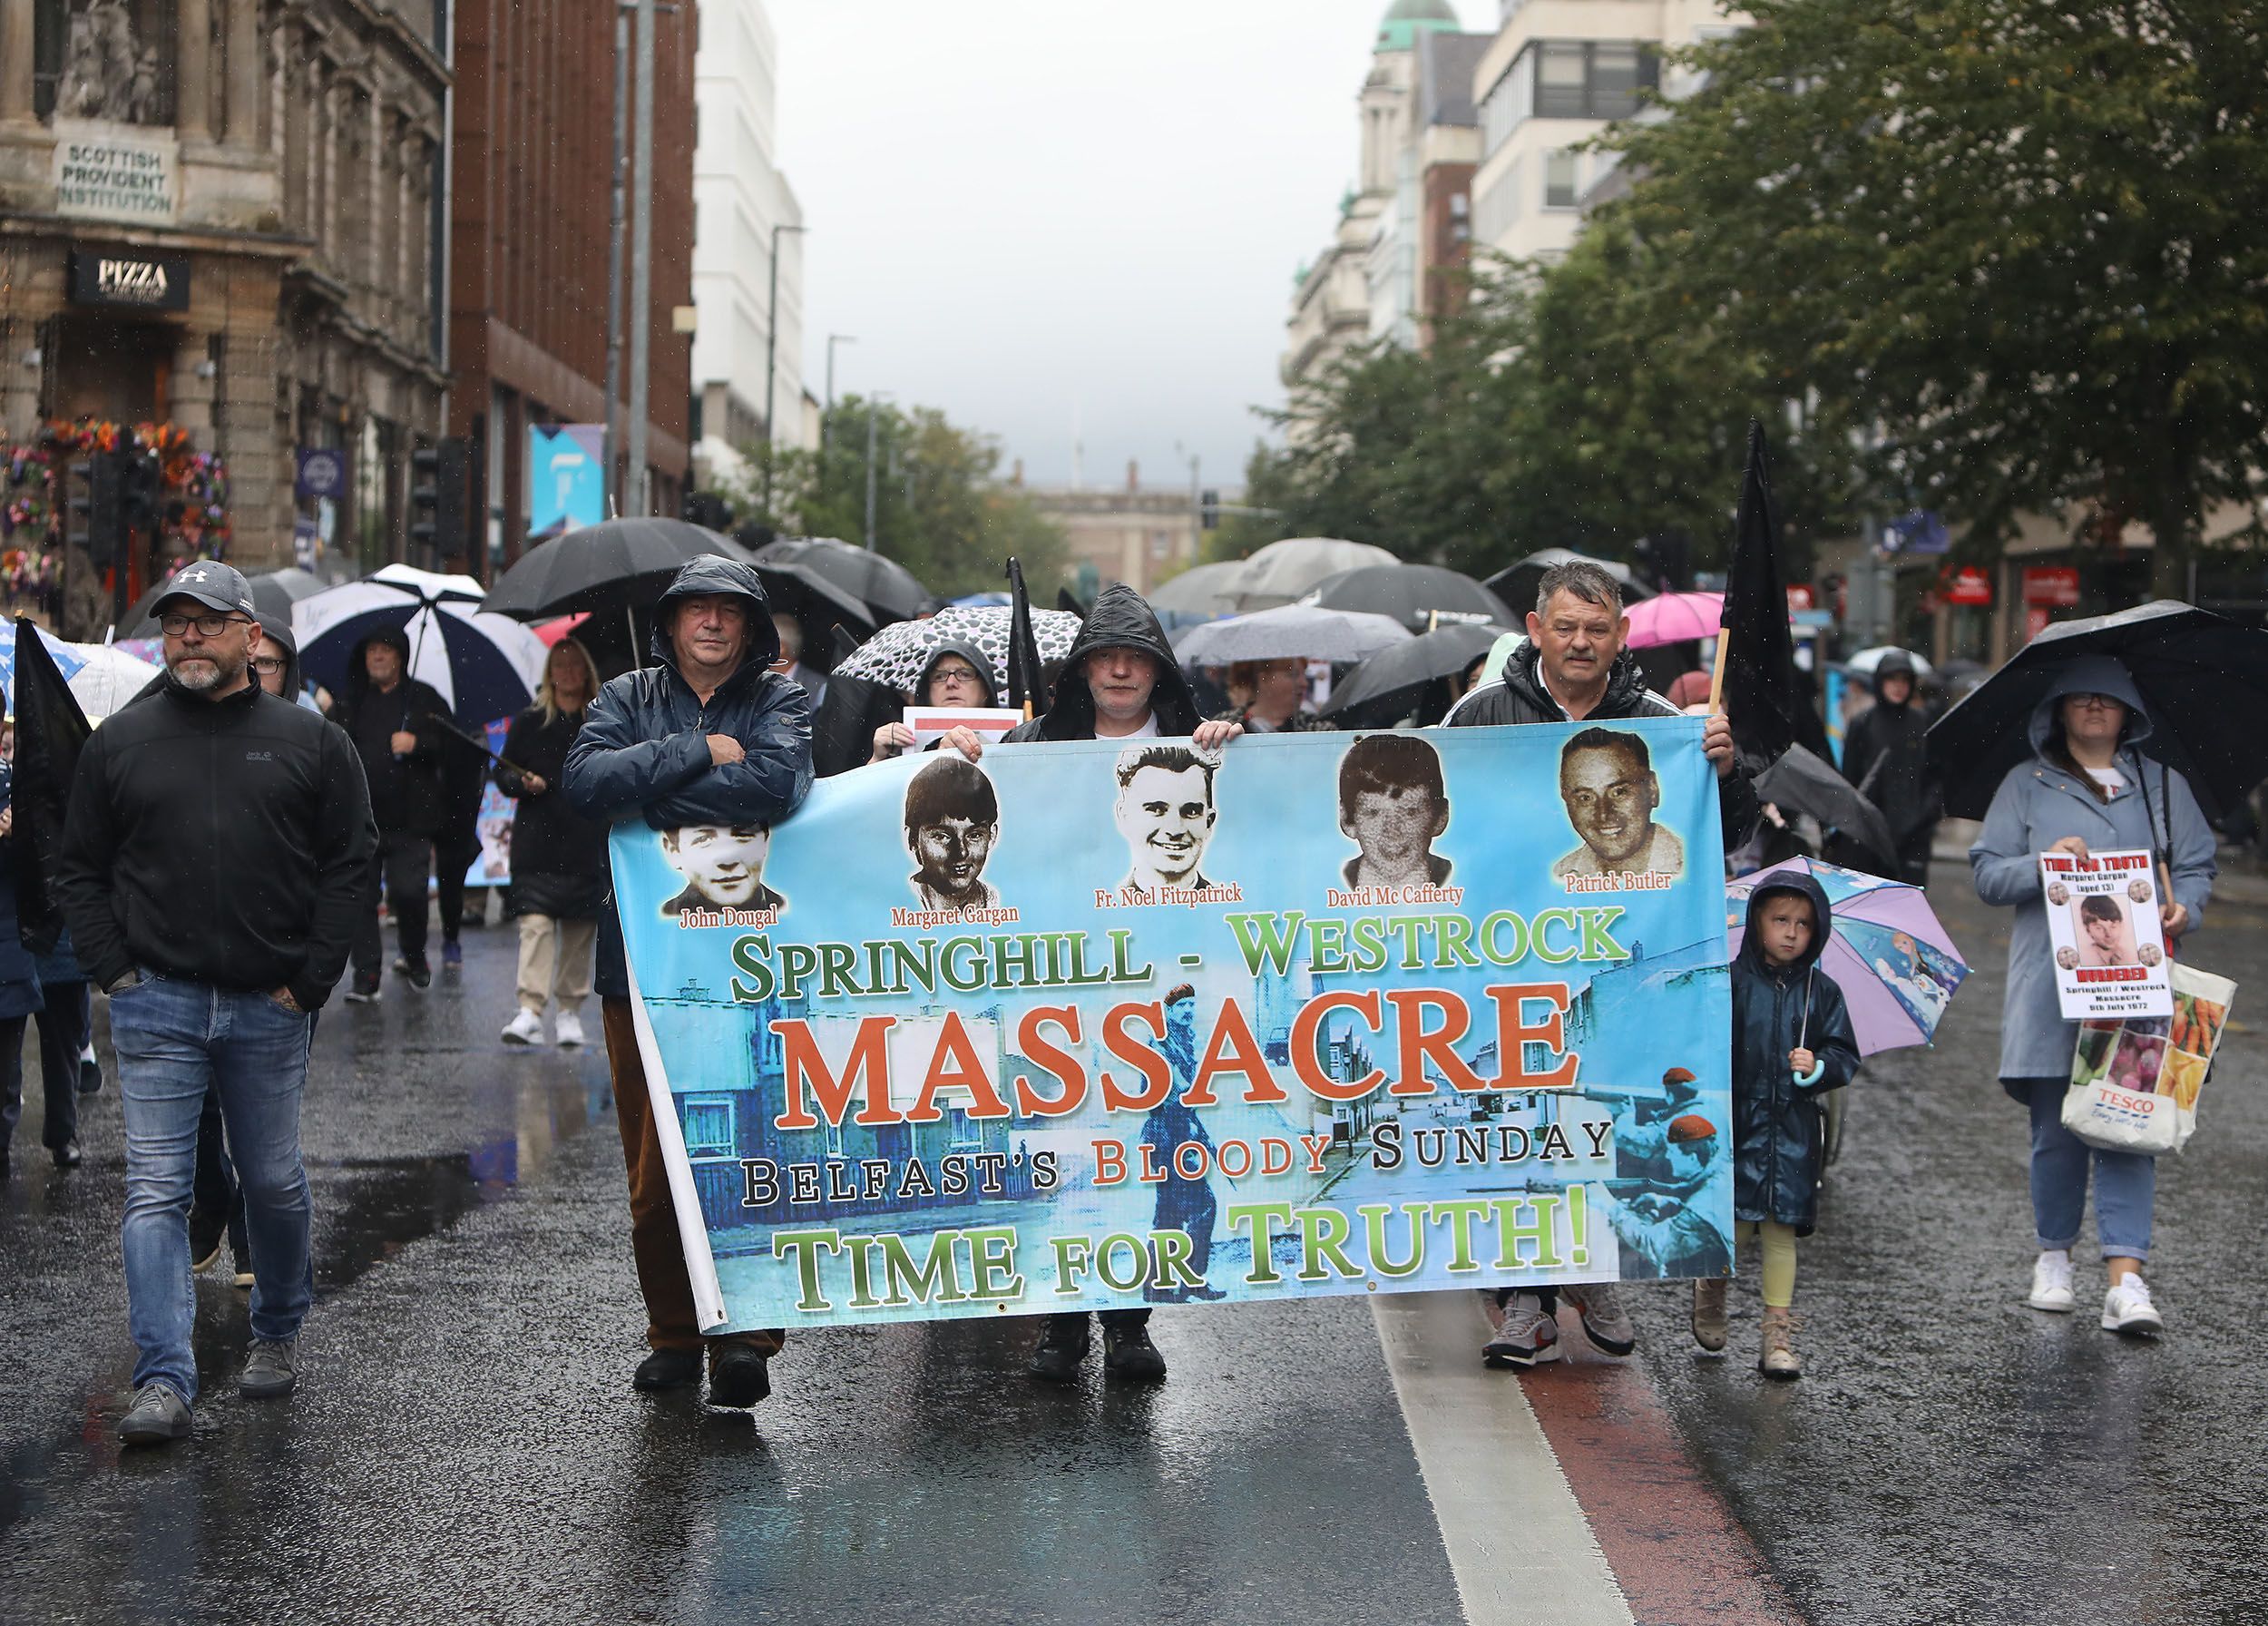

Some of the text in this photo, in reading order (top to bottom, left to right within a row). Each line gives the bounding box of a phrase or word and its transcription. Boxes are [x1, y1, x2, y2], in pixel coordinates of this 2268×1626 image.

[69, 145, 161, 169] SCOTTISH
[63, 164, 165, 191] PROVIDENT
[98, 259, 167, 289] PIZZA
[2044, 857, 2074, 871] TIME
[2103, 855, 2148, 870] TRUTH
[1566, 870, 1671, 893] Patrick Butler
[2060, 871, 2128, 882] Margaret Gargan
[1095, 882, 1243, 907] Fr. Noel Fitzpatrick
[1327, 882, 1464, 907] David Mc Cafferty
[679, 903, 778, 929] John Dougal
[891, 905, 1019, 930] Margaret Gargan
[731, 931, 1152, 1002] SPRINGHILL
[1226, 906, 1630, 976] WESTROCK
[2076, 967, 2149, 983] MURDERED
[2066, 986, 2112, 994] Springhill
[2121, 984, 2167, 993] Westrock
[2096, 994, 2142, 1003] Massacre
[2107, 1003, 2126, 1012] July
[768, 983, 1579, 1130] MASSACRE
[2099, 1088, 2155, 1113] TESCO
[741, 1120, 1613, 1207] BELFAST'S BLOODY SUNDAY
[772, 1184, 1590, 1312] TIME FOR TRUTH!
